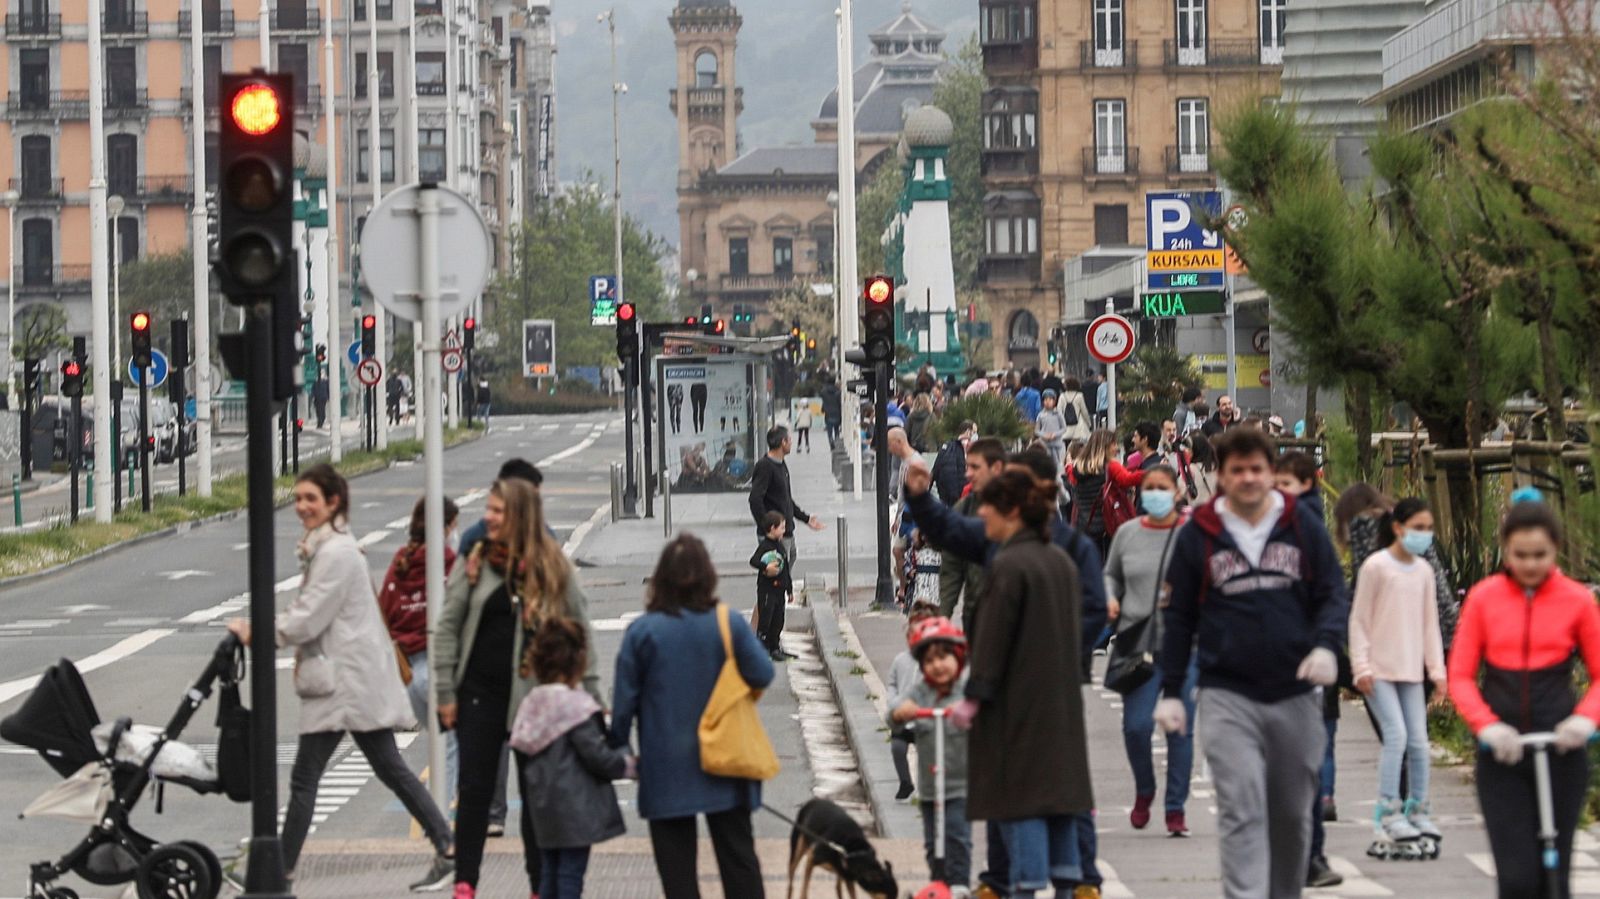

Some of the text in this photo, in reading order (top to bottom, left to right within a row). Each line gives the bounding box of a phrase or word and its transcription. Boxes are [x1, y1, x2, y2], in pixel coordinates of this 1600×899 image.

[1151, 199, 1191, 251] P
[1171, 238, 1192, 250] 24h
[1152, 254, 1218, 267] KURSAAL
[1170, 273, 1198, 286] LIBRE
[595, 278, 608, 300] P
[1145, 293, 1187, 317] KUA
